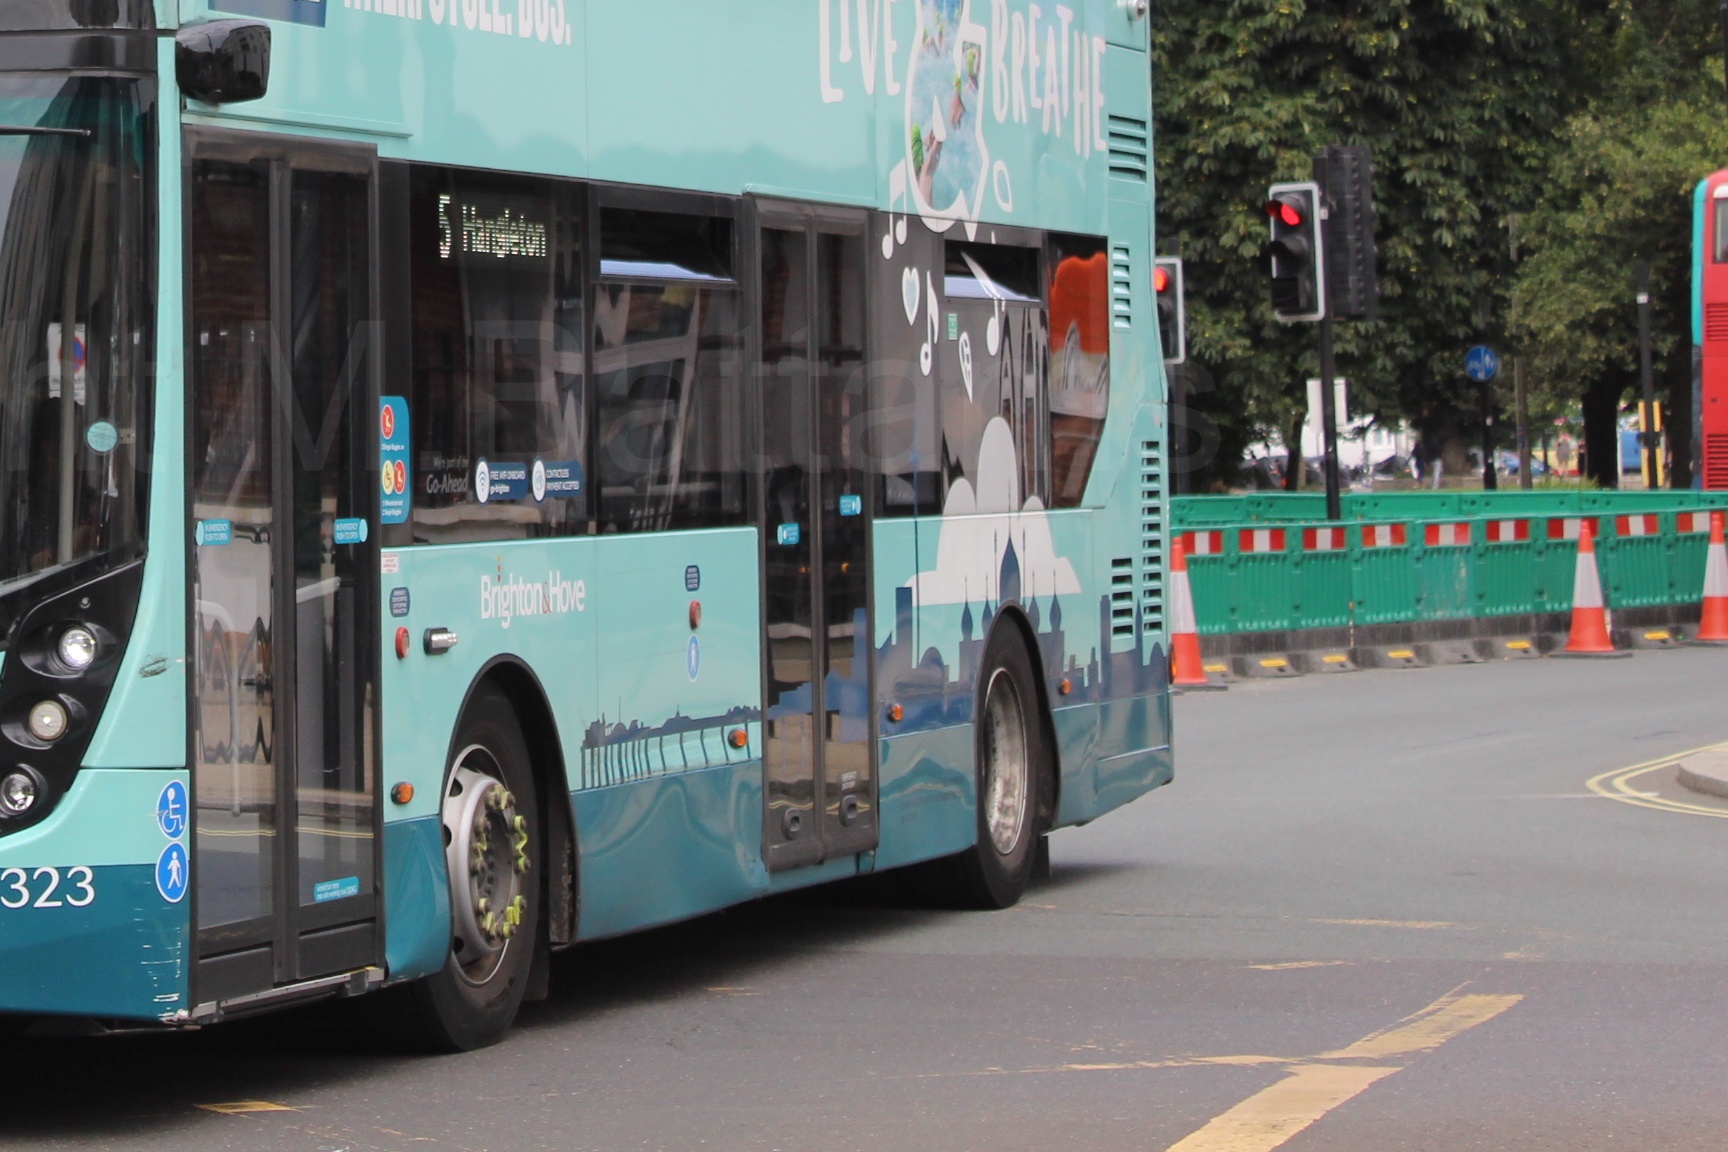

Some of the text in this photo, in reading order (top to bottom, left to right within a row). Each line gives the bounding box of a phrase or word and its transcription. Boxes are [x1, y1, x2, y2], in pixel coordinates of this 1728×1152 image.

[438, 195, 547, 259] 5 Hangleton
[426, 469, 470, 494] Go-Ahead
[480, 555, 586, 629] Brighton&Hove
[0, 866, 95, 908] 323
